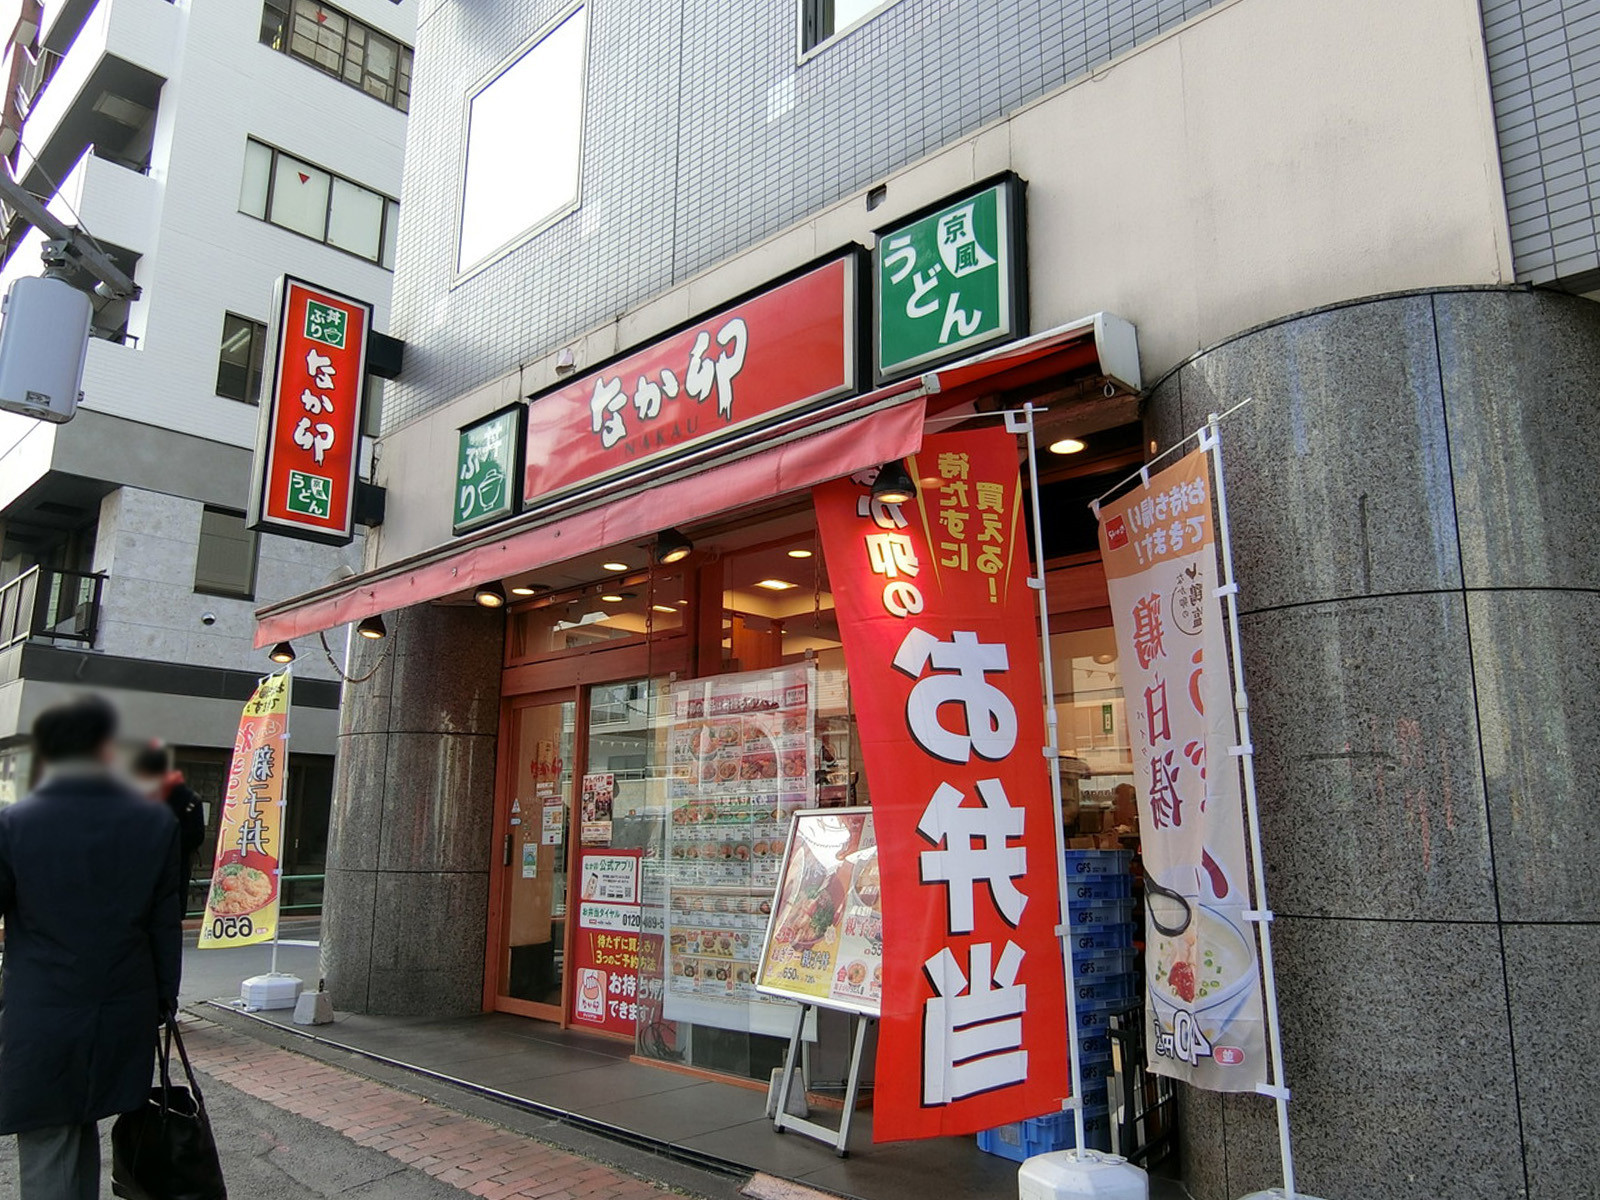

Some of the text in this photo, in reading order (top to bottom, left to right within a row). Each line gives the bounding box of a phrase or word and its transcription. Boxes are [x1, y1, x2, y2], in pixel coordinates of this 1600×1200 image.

[943, 212, 980, 274] 京風
[884, 233, 983, 345] うどん
[589, 318, 748, 449] なか卯
[293, 347, 336, 468] なか卯
[623, 415, 700, 456] NAKAU
[292, 474, 324, 515] うどん
[599, 859, 634, 872] 公式アプリ
[1076, 863, 1091, 873] GFS
[1077, 888, 1093, 898] GFS
[582, 908, 621, 919] お弁当ダイヤル
[1078, 912, 1093, 922] GFS
[1079, 938, 1094, 949] GFS
[595, 950, 657, 972] 3つのご予約方法
[1080, 963, 1095, 974] GFS
[1080, 988, 1094, 999] GFS
[1082, 1014, 1097, 1026] GFS
